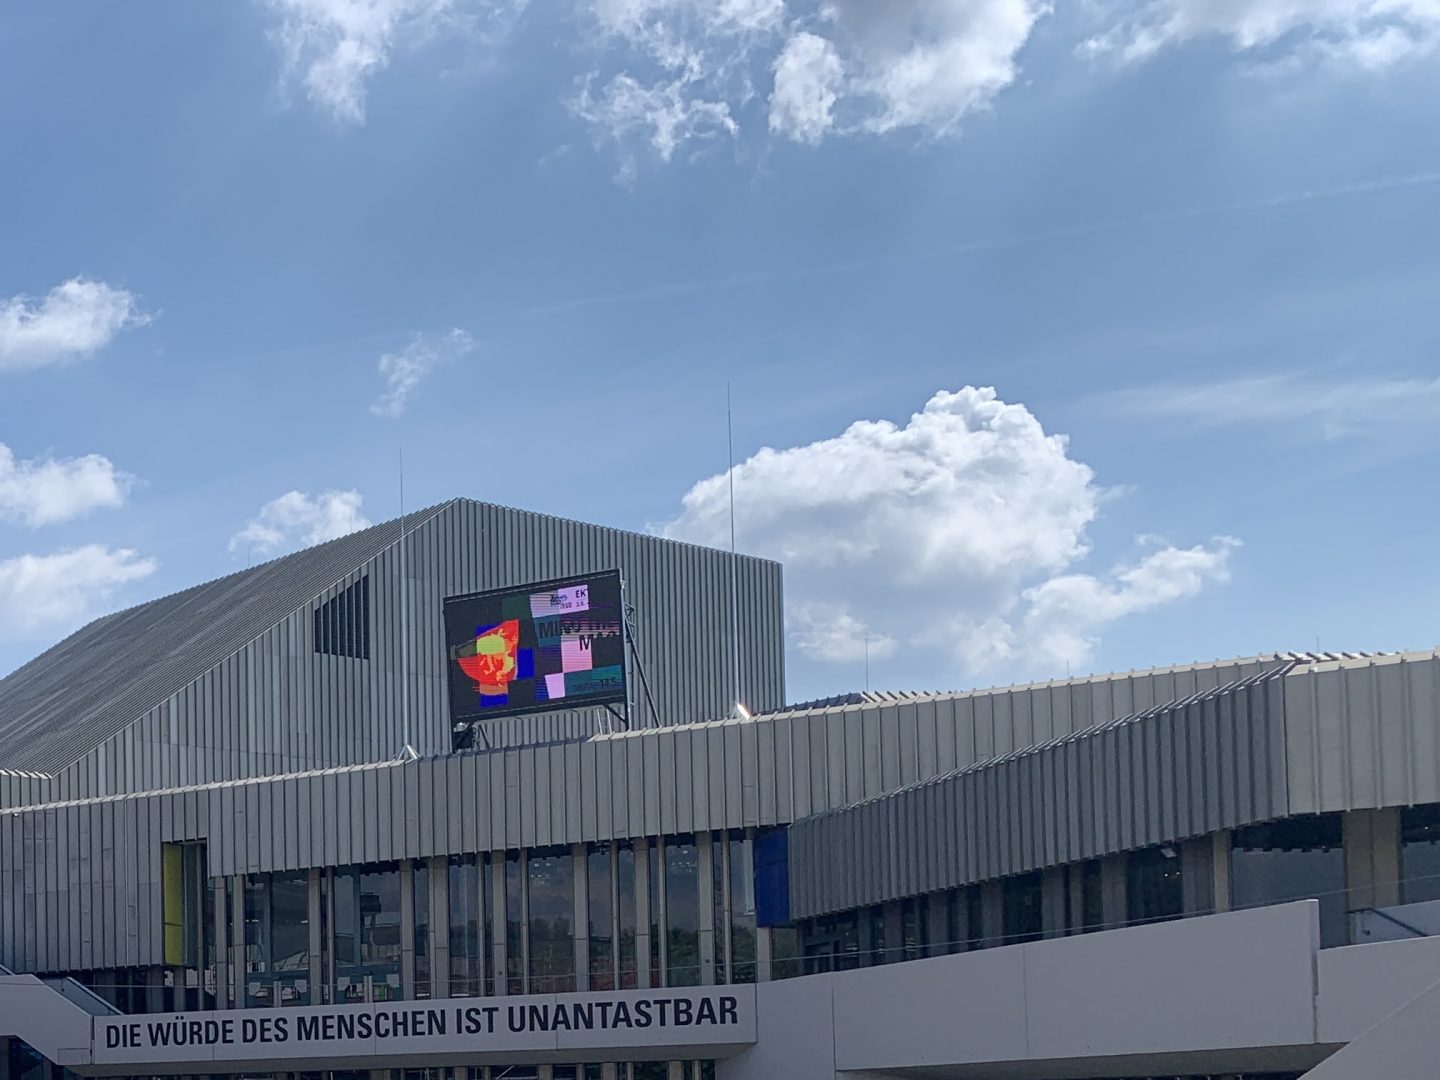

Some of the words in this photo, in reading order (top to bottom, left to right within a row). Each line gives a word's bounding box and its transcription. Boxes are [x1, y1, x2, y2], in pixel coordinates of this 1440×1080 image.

[107, 1024, 142, 1048] DIE
[148, 1015, 235, 1047] WÜRDE
[242, 1018, 289, 1044] DES
[297, 1009, 446, 1041] MENSCHEN
[456, 1007, 500, 1034] IST
[508, 996, 738, 1033] UNANTASTBAR
